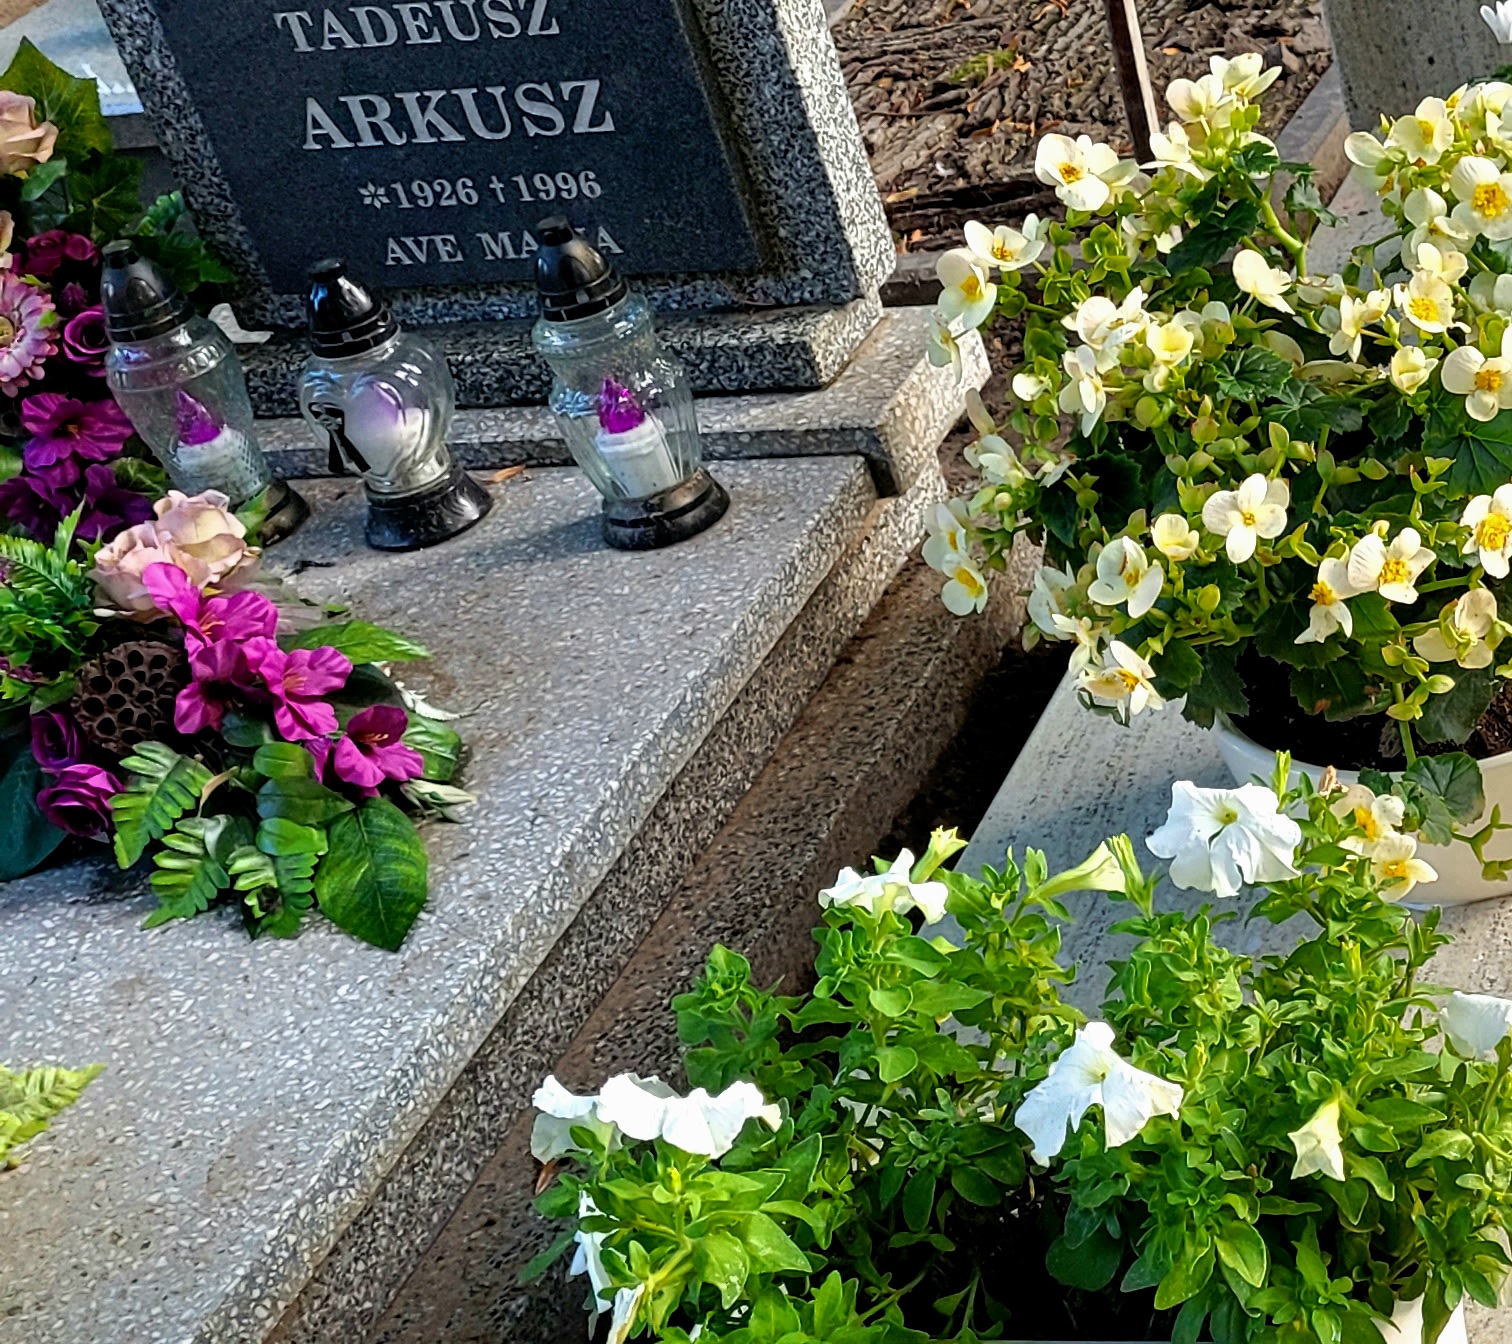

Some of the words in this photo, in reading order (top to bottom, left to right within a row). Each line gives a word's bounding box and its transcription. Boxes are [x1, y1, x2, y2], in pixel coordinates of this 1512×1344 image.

[301, 78, 616, 151] ARKUSZ
[384, 233, 465, 266] AVE
[475, 225, 625, 261] MAA
